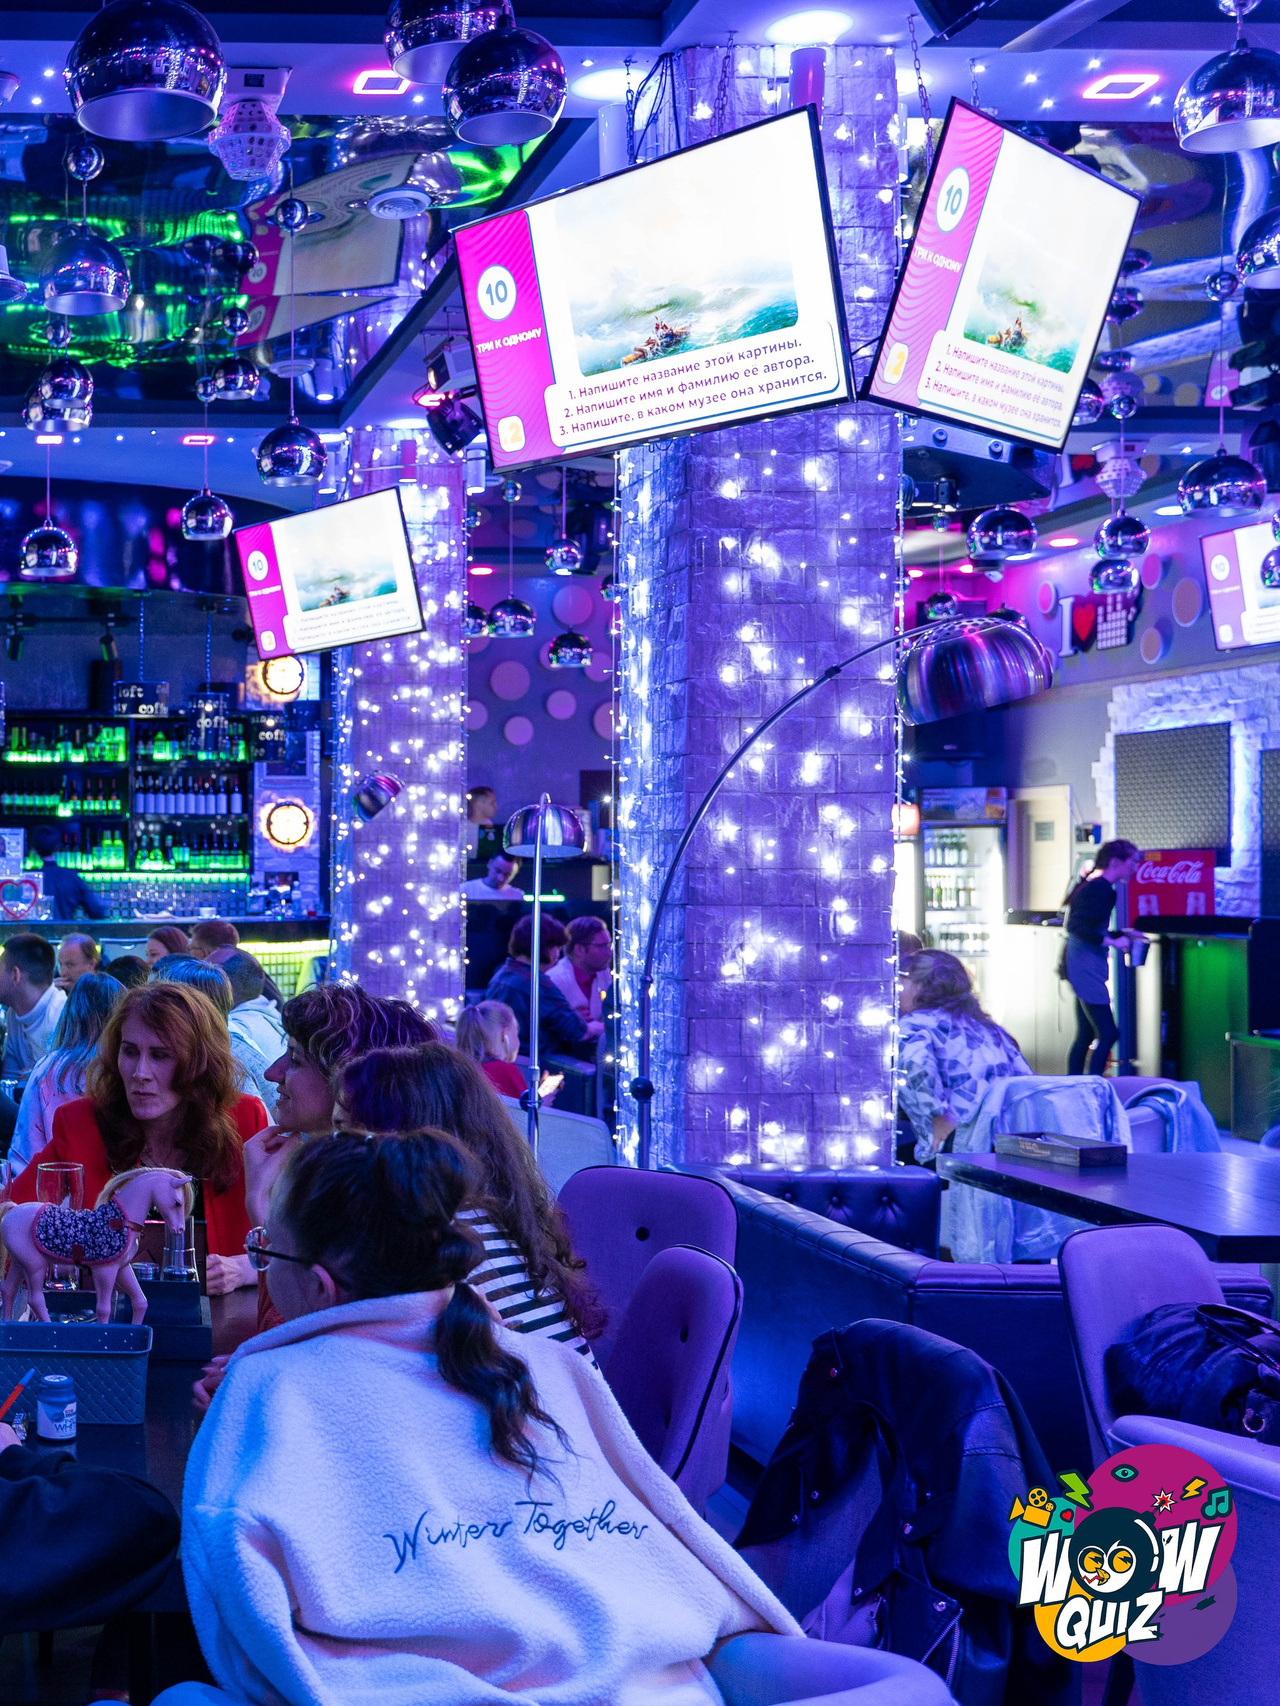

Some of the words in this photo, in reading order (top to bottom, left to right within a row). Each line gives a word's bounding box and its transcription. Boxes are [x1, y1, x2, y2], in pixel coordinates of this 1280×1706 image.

[944, 184, 963, 216] 10
[914, 245, 928, 260] ТРИ
[928, 250, 935, 262] К
[933, 253, 963, 274] ОДНОМУ
[485, 280, 508, 306] 10
[476, 339, 494, 354] ТРИ
[494, 337, 503, 350] К
[503, 327, 542, 347] ОДНОМУ
[568, 390, 577, 400] 1.
[579, 376, 639, 398] Напишите
[643, 361, 701, 383] название
[704, 351, 734, 369] этой
[738, 339, 802, 360] картины.
[943, 363, 980, 384] Напишите
[953, 348, 989, 368] Напишите
[989, 360, 1020, 379] название
[564, 407, 574, 418] 2.
[576, 395, 636, 415] Напишите
[639, 388, 663, 401] имя
[666, 386, 675, 395] и
[677, 371, 740, 394] фамилию
[743, 364, 759, 377] её
[763, 355, 815, 373] автора.
[559, 425, 569, 436] 3.
[571, 412, 634, 433] Напишите,
[637, 410, 644, 419] в
[647, 402, 685, 417] каком
[688, 392, 727, 409] музее
[730, 386, 754, 399] она
[758, 371, 827, 394] хранится.
[252, 559, 264, 571] 10
[382, 1510, 512, 1574] Winter
[515, 1499, 648, 1551] Together
